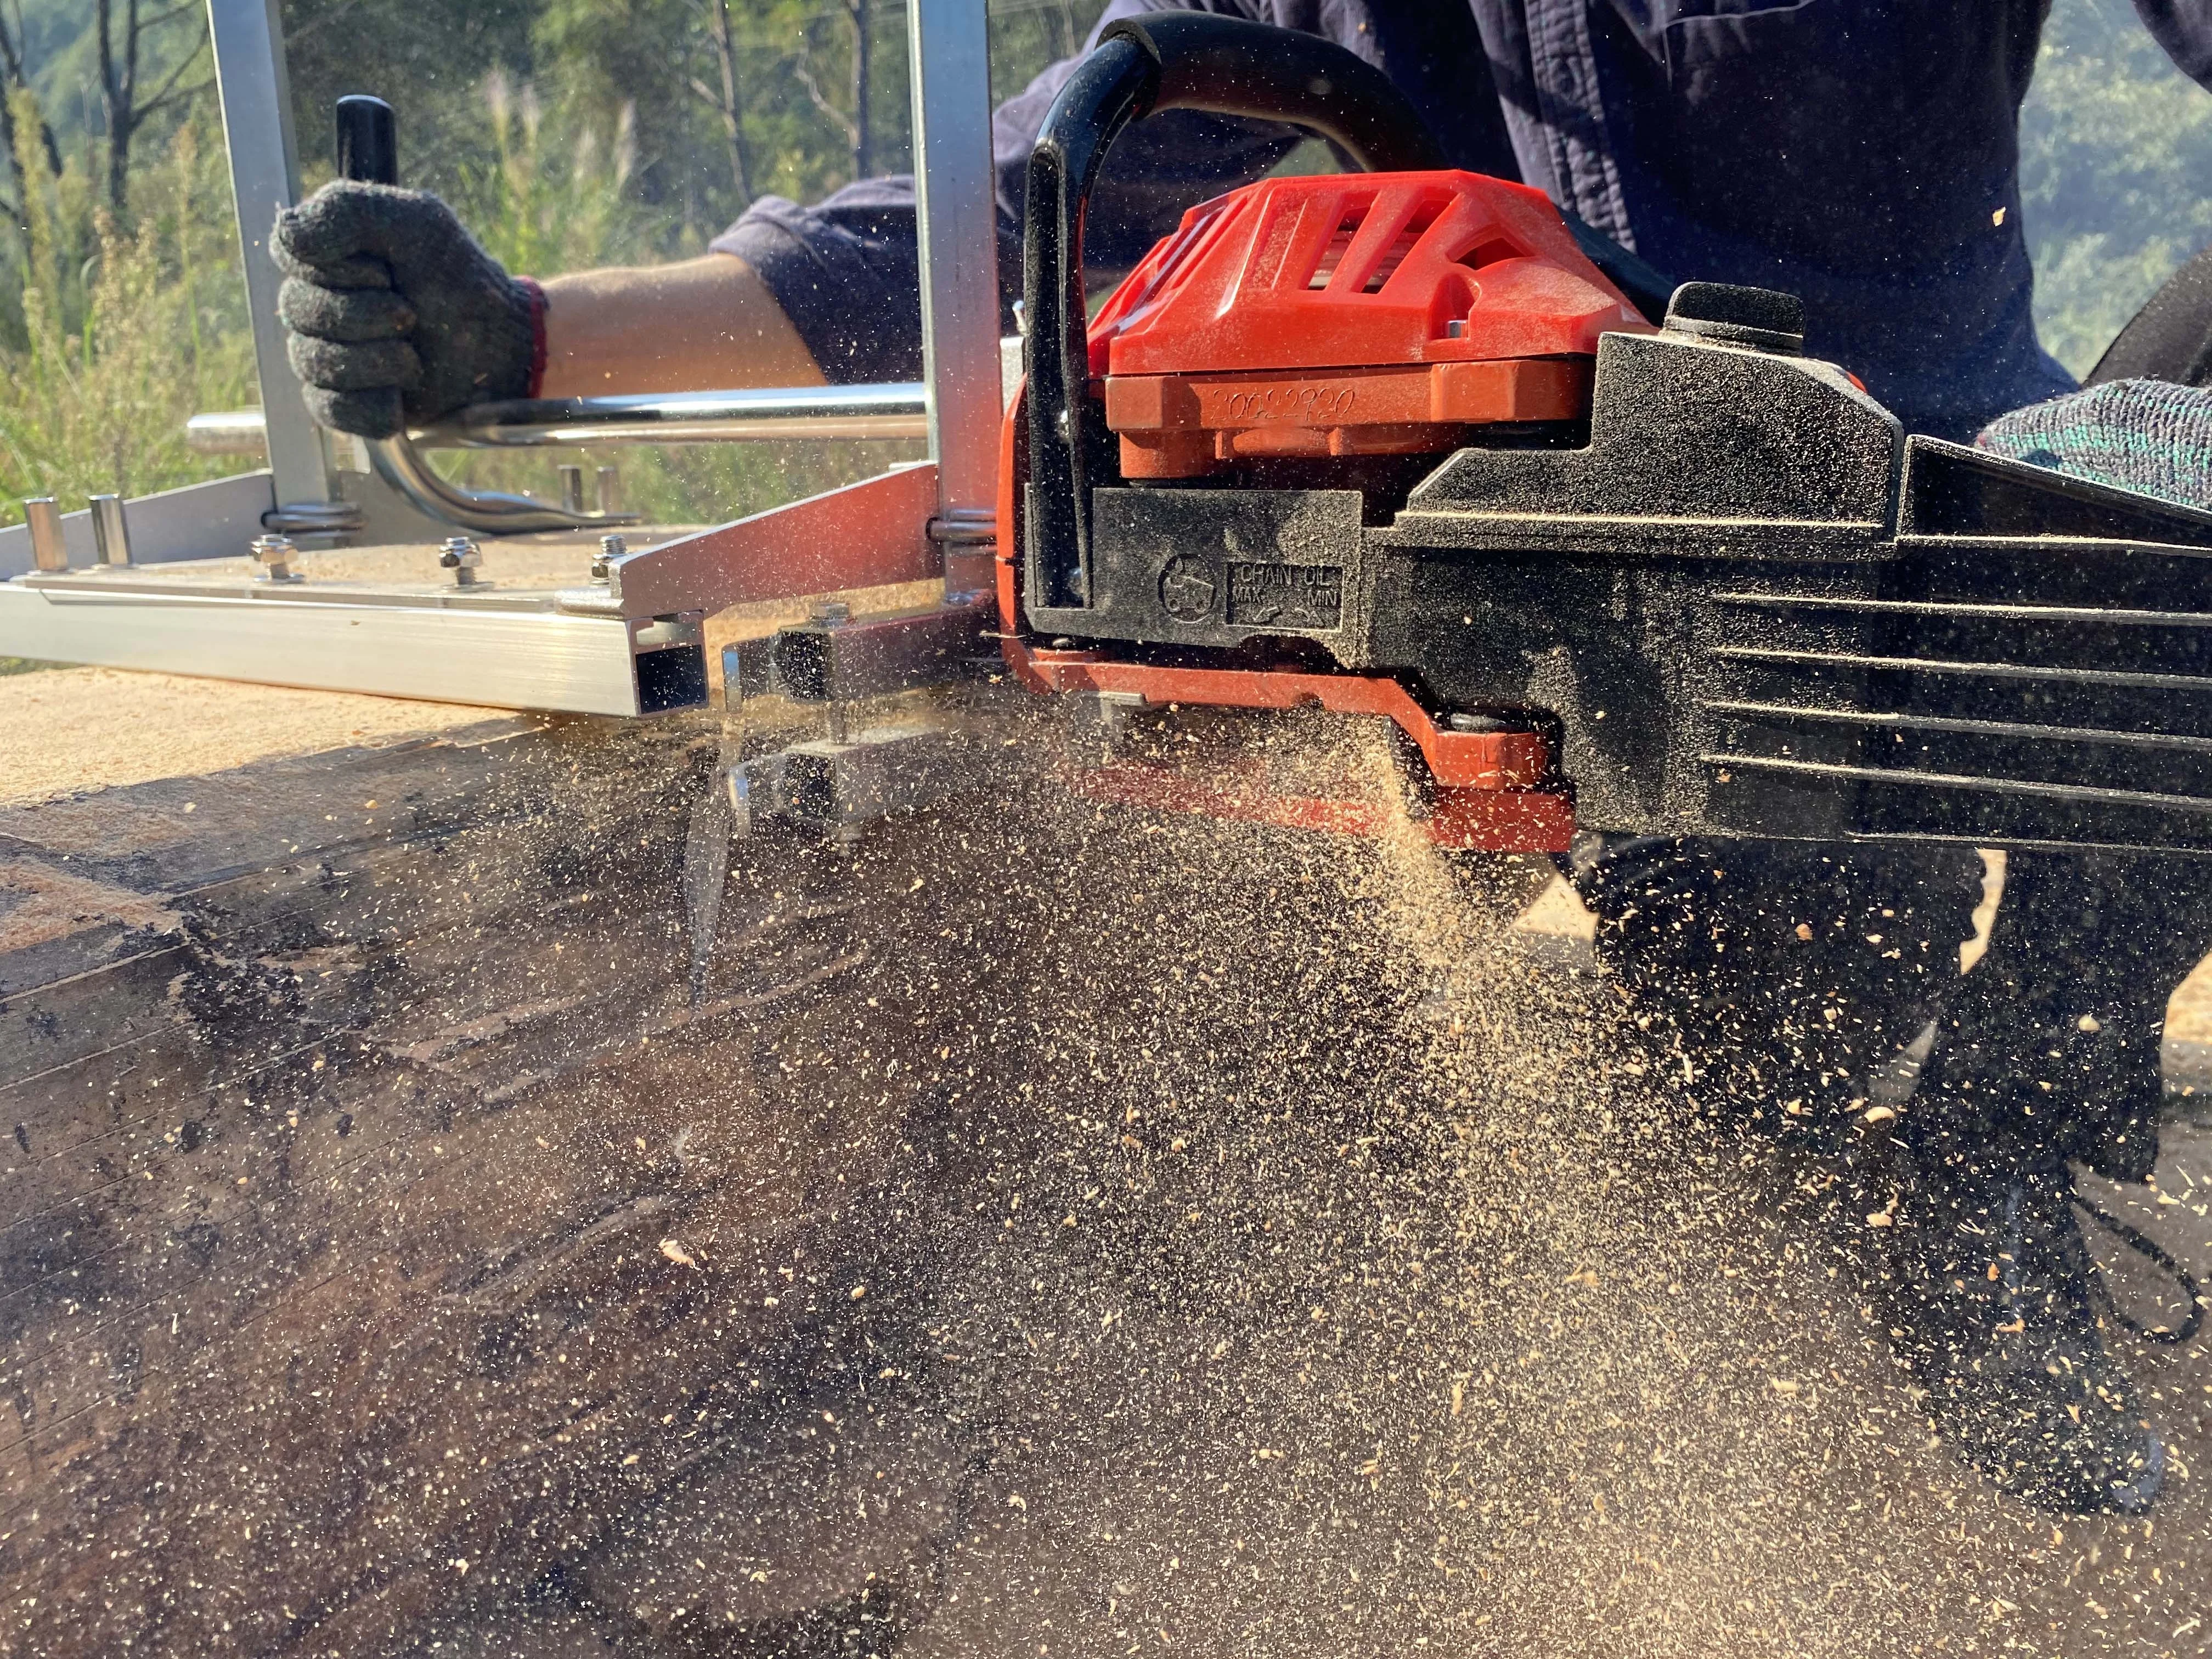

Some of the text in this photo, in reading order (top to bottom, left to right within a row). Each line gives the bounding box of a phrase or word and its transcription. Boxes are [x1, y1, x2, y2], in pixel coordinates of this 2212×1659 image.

[1240, 563, 1331, 586] CHAIN OIL
[1232, 585, 1338, 606] MAX MIN
